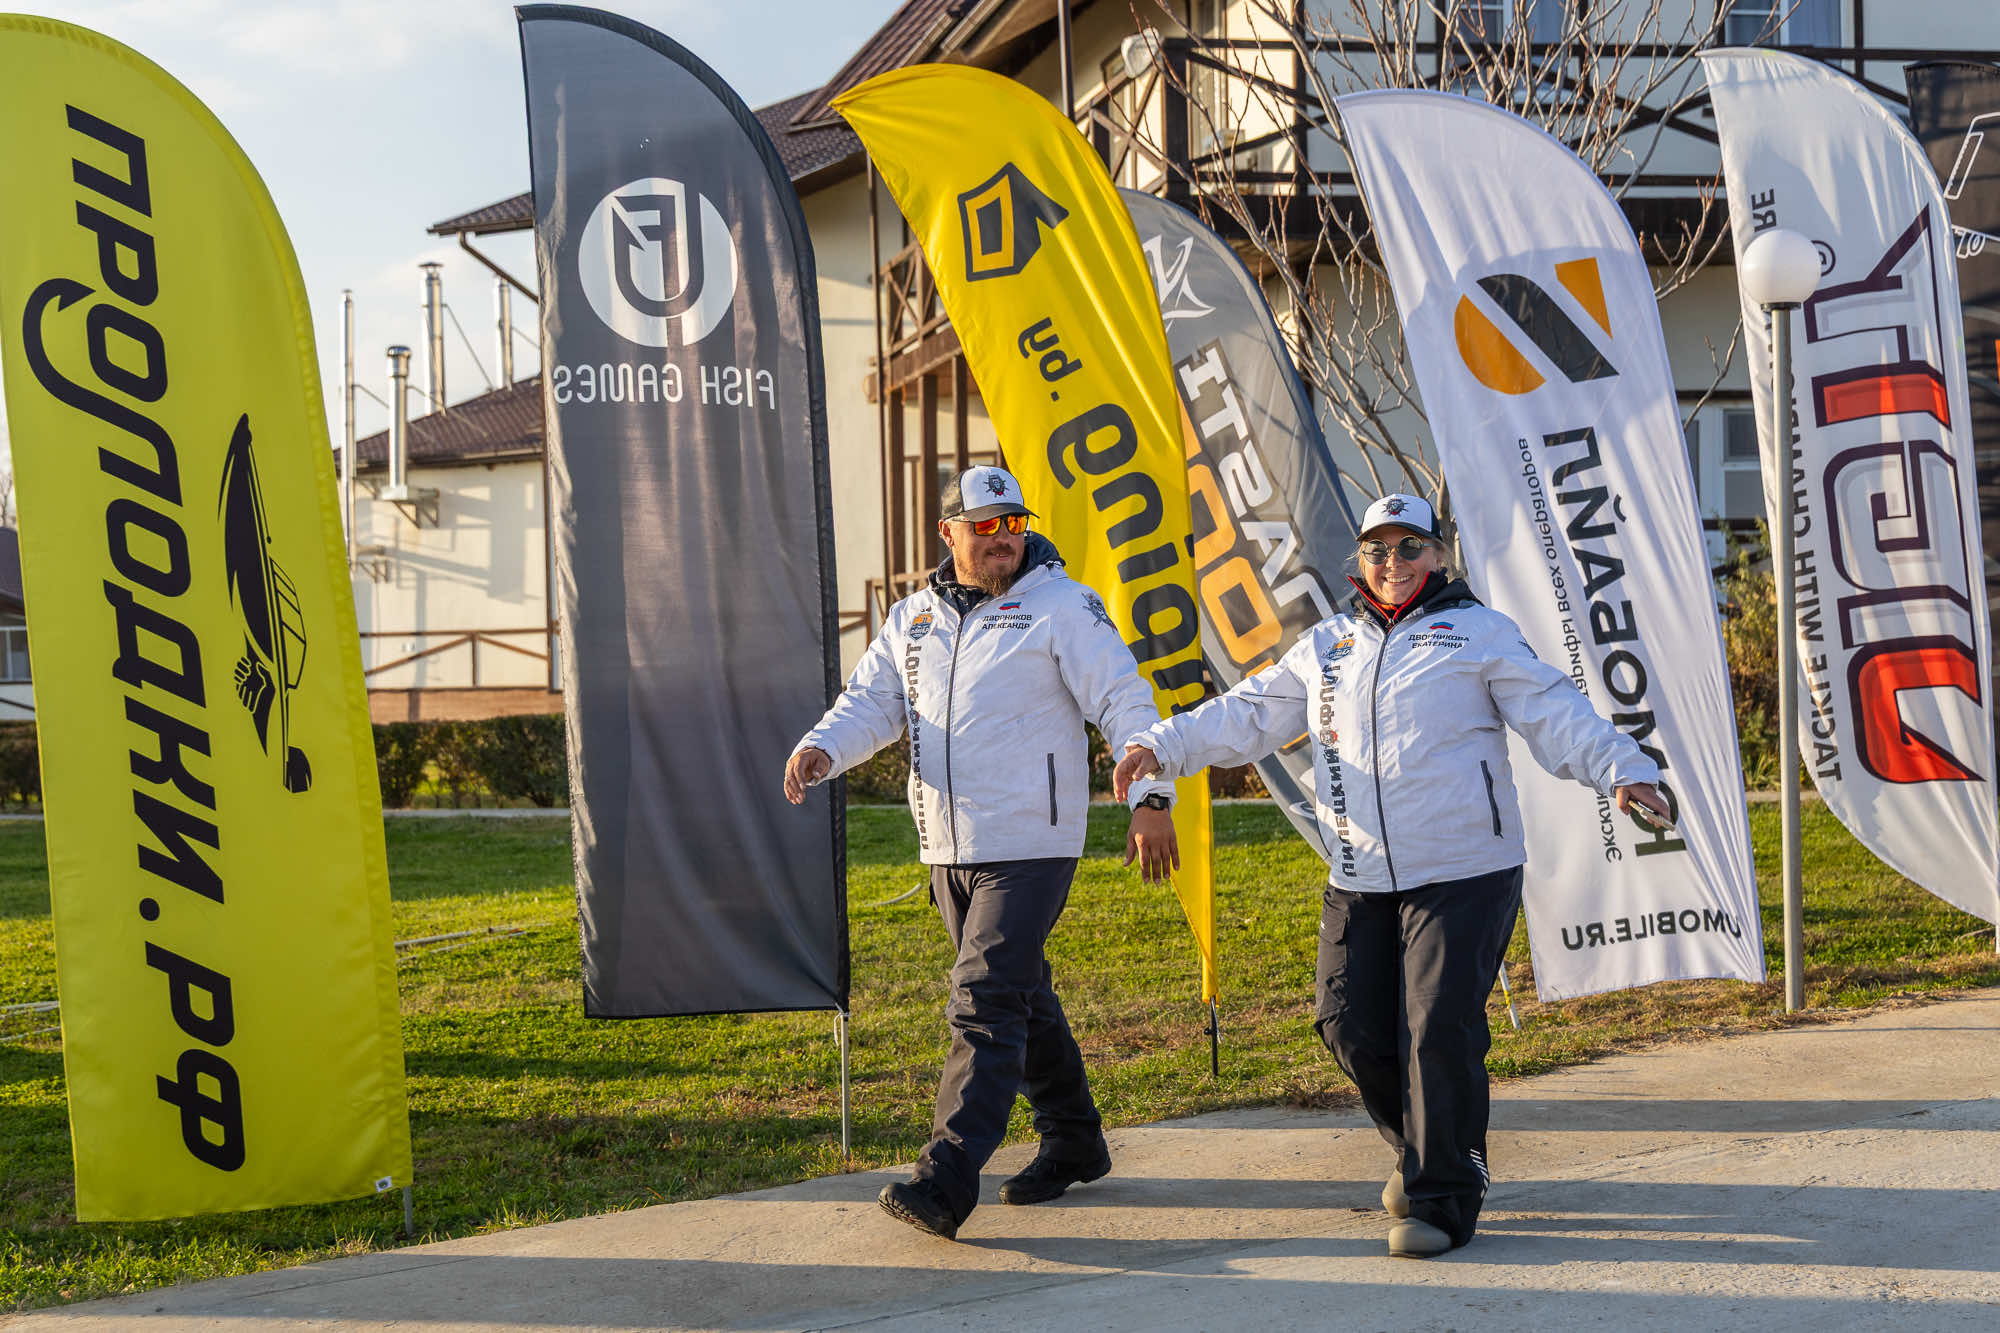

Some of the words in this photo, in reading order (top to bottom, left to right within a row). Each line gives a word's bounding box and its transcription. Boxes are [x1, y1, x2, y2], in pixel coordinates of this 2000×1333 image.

[982, 614, 1033, 622] ДВОРНИКОВ
[982, 622, 1030, 630] АЛЕКСАНДР
[1407, 633, 1470, 641] ДВОРНИКОВА
[1411, 641, 1463, 649] ЕКАТЕРИНА
